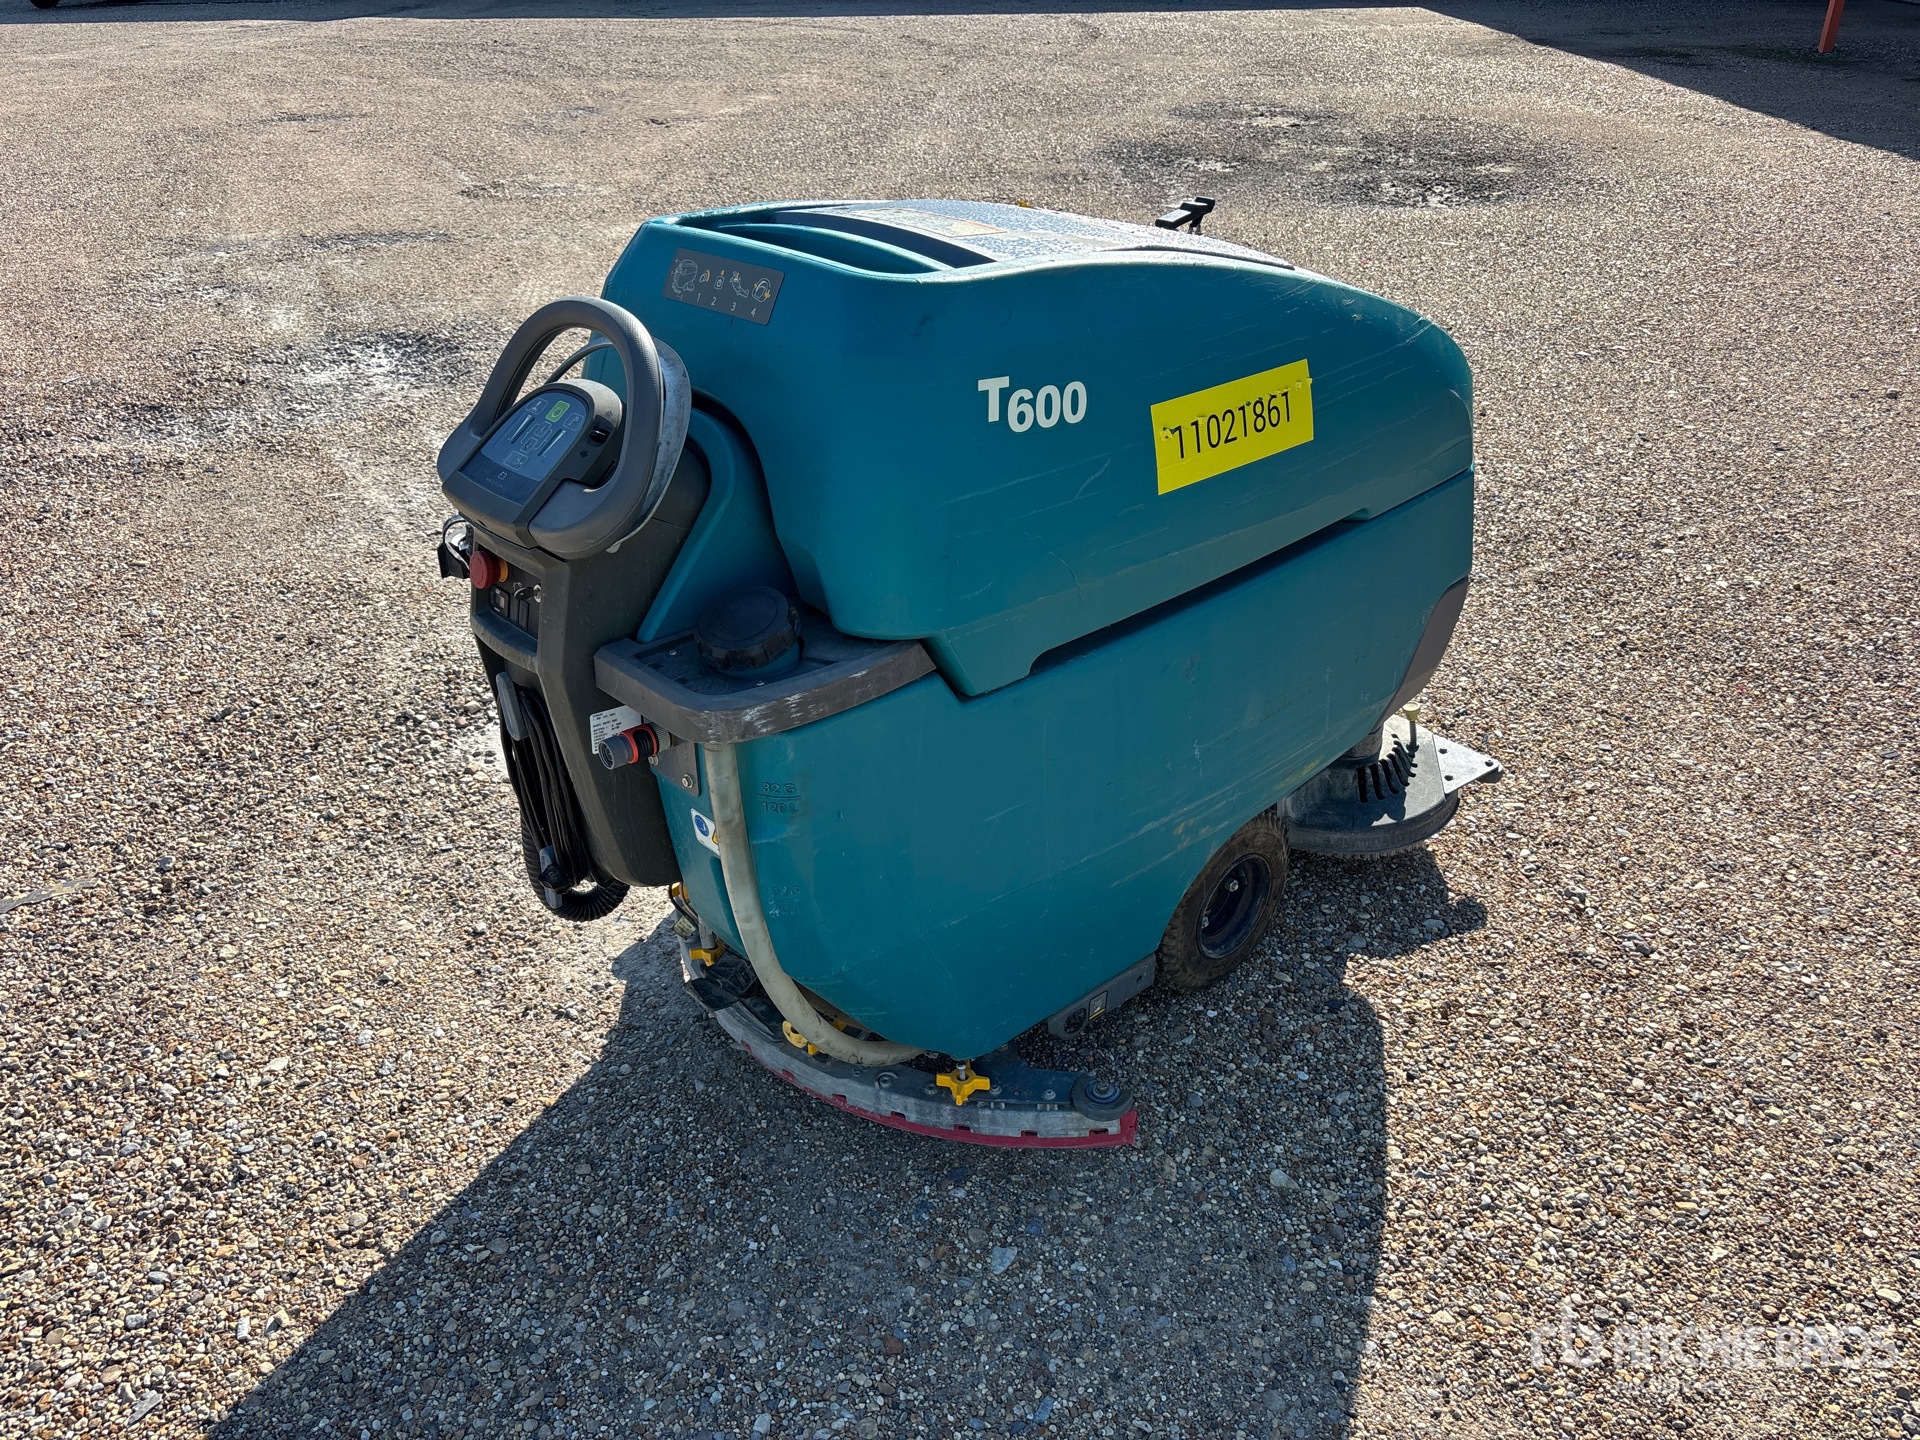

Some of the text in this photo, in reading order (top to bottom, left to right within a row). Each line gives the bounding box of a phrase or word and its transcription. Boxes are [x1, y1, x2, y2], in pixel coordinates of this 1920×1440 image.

[711, 296, 717, 306] 2
[730, 302, 737, 312] 3
[751, 307, 757, 317] 4
[977, 376, 1087, 433] T600
[1172, 391, 1290, 459] 11021861
[762, 782, 797, 794] 32 G
[761, 801, 786, 813] 120
